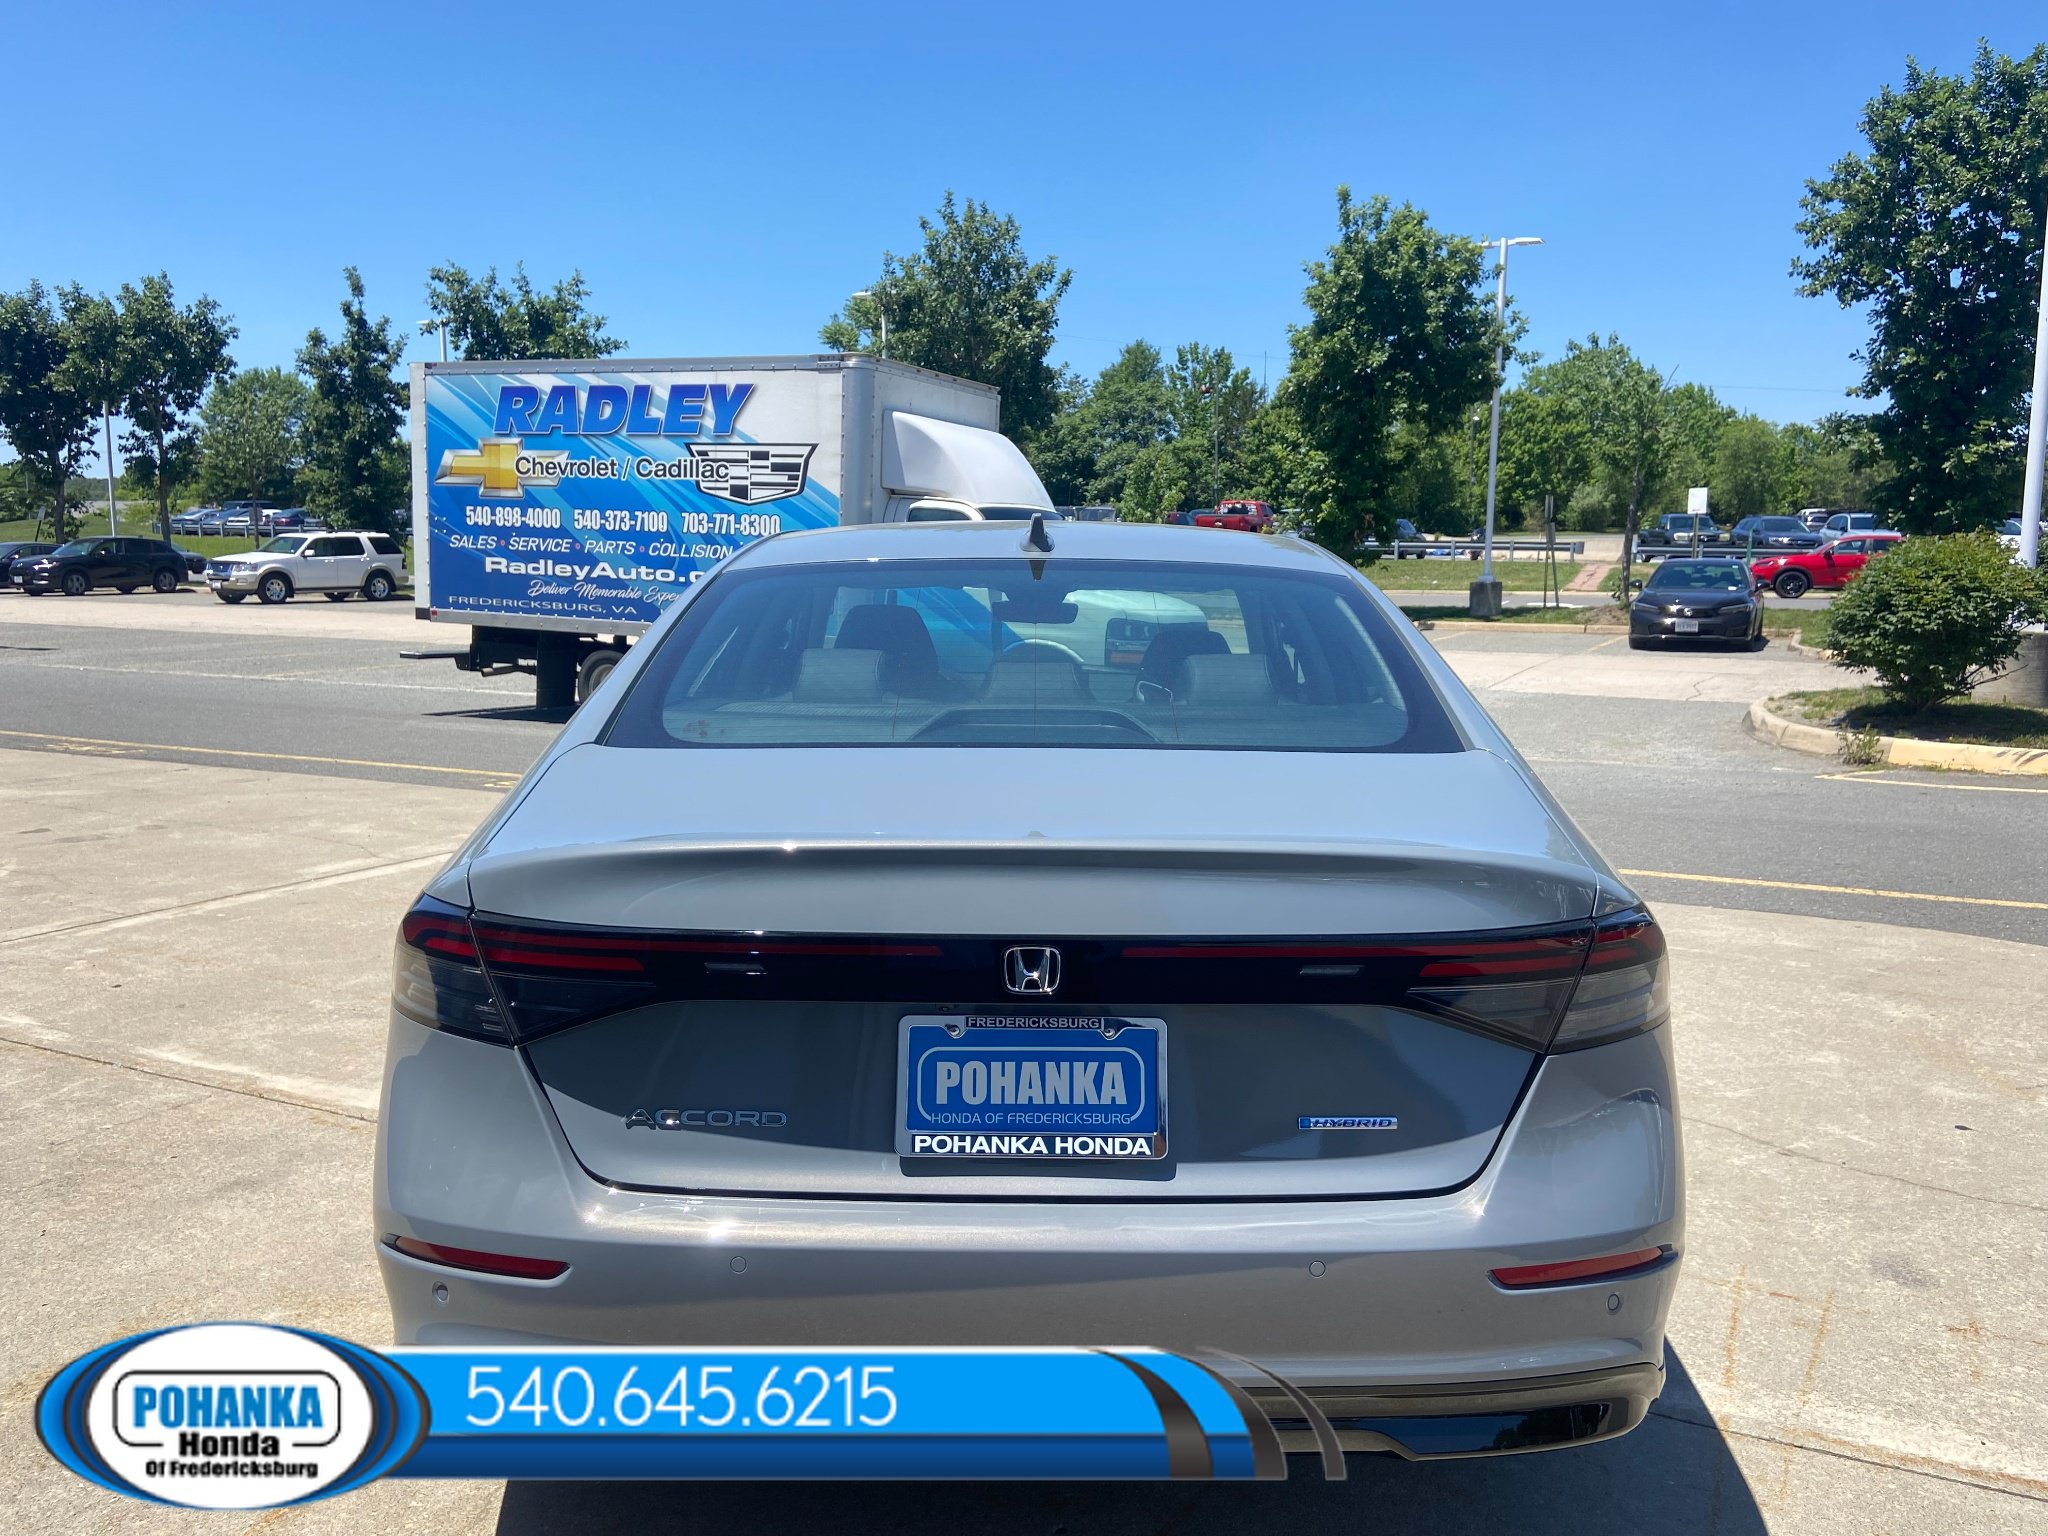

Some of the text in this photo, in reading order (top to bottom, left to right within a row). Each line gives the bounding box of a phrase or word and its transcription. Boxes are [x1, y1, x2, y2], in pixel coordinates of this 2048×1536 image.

[493, 384, 754, 435] RADLEY
[514, 455, 619, 480] Chevrolet
[634, 459, 730, 481] Cadillac
[465, 506, 561, 529] 540-898-4000
[573, 509, 668, 532] 540-373-7100
[681, 513, 781, 536] 703-771-8300
[449, 534, 733, 559] SALES SERVICE PARTS COLLISION
[528, 579, 572, 597] Deliver
[573, 581, 642, 601] Memorable
[448, 595, 637, 614] FREDERICKSBURG, VA
[967, 1016, 1100, 1029] FREDERICKSBURG
[936, 1060, 1128, 1105] POHANKA
[626, 1108, 787, 1127] ACCORD
[931, 1112, 1131, 1125] HONDA OF FREDERICKSBURG
[1311, 1118, 1393, 1128] HYBRID
[914, 1135, 1151, 1155] POHANKA HONDA
